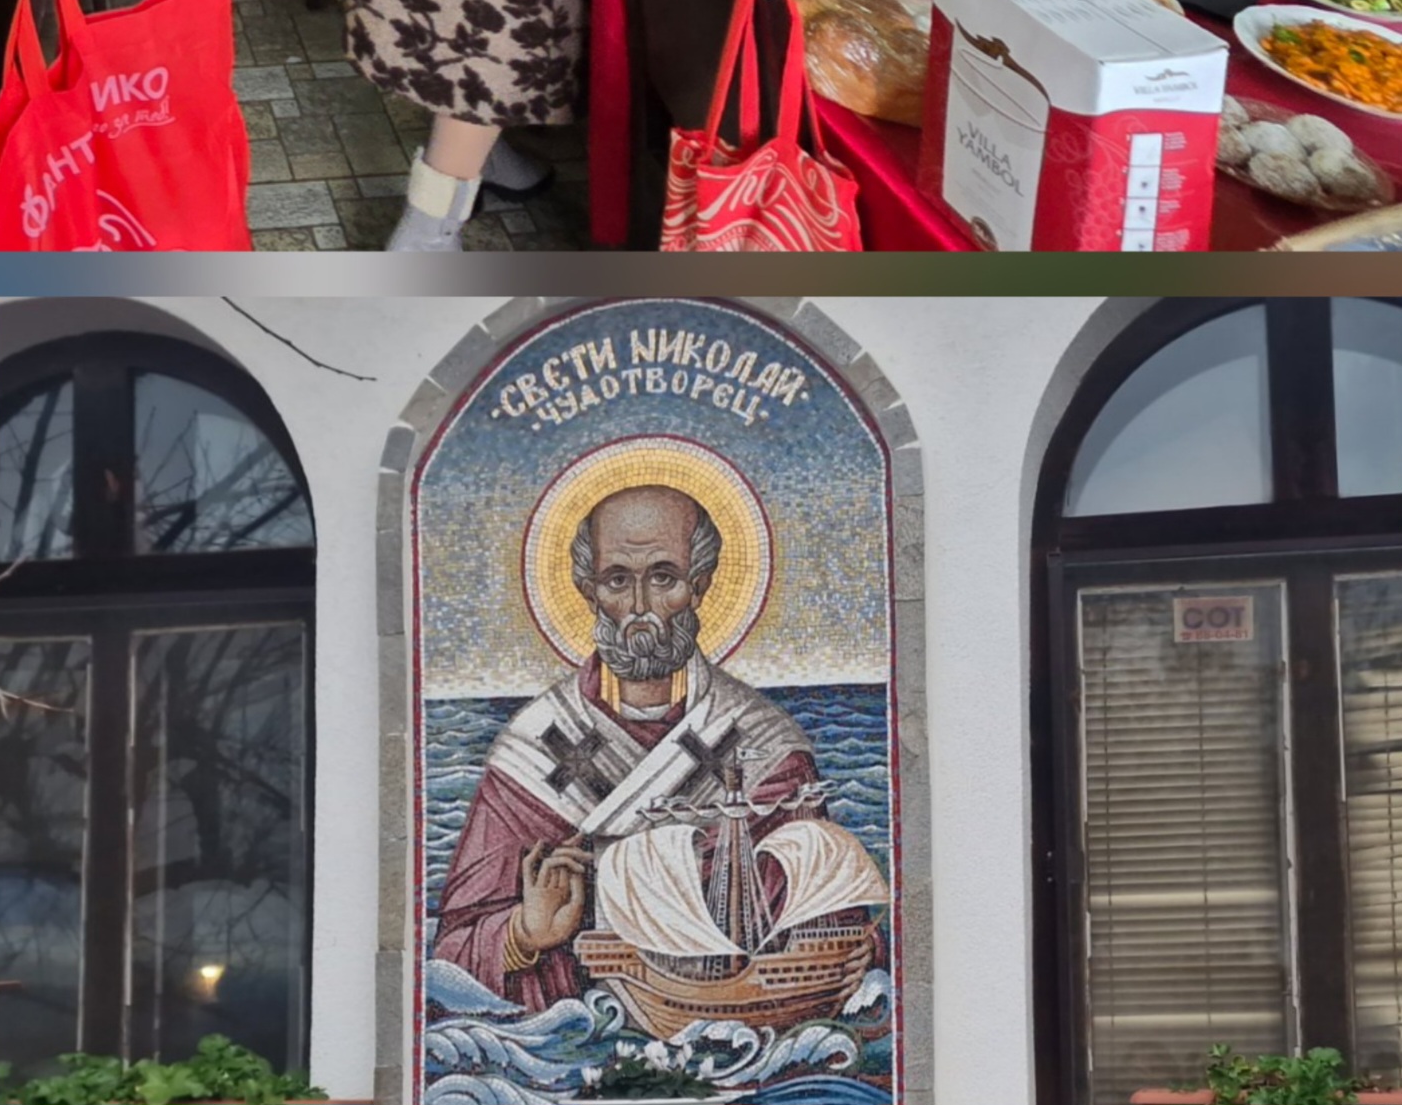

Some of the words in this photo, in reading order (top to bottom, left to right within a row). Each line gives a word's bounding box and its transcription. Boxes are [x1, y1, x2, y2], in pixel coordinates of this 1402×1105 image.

[90, 66, 169, 112] ИКО
[956, 125, 1025, 198] YAMBOL
[966, 120, 1012, 171] VILLA
[500, 336, 617, 419] СВЕТИ
[538, 366, 759, 427] ЧУДОТВОРЕЦ
[1182, 605, 1246, 630] СОТ
